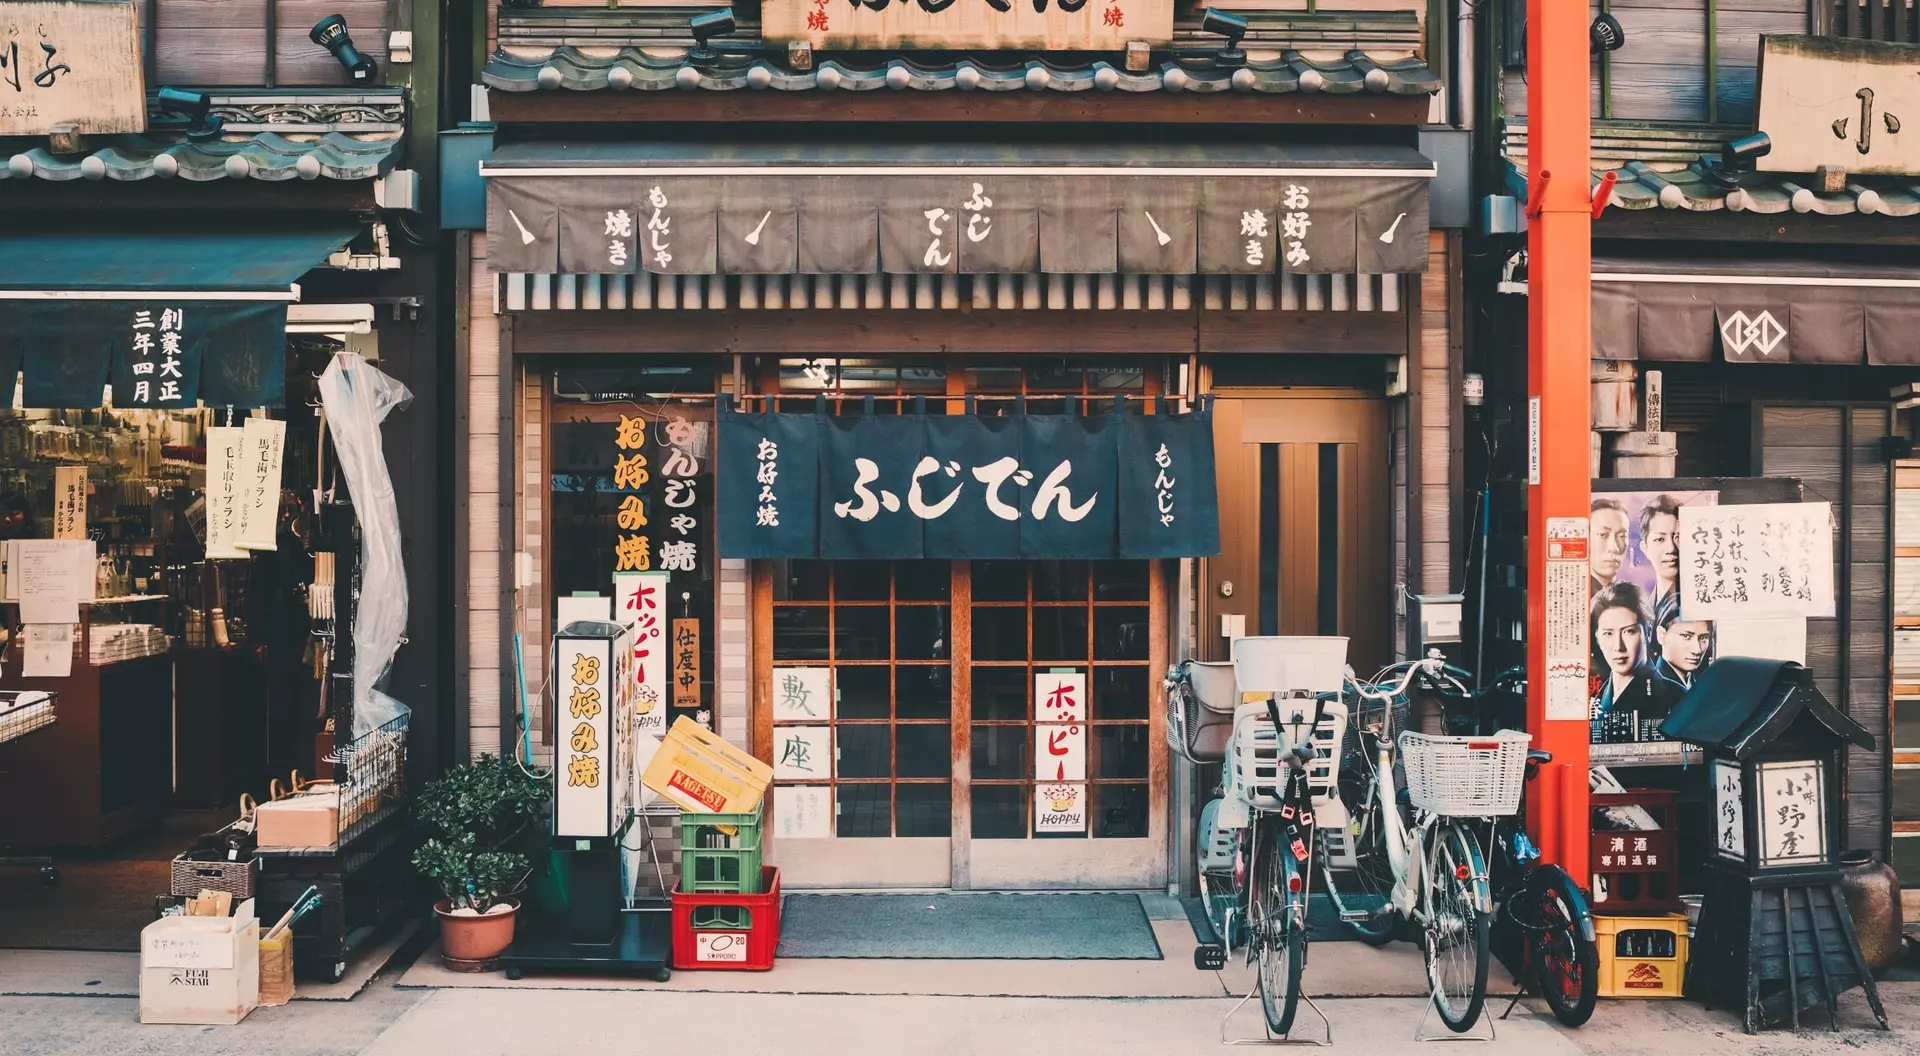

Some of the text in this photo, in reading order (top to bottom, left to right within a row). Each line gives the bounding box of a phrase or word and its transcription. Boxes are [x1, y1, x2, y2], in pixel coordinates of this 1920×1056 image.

[1832, 87, 1900, 155] 小
[604, 209, 632, 266] 焼き
[648, 186, 672, 268] もんじゃ
[924, 208, 951, 266] でん
[964, 183, 993, 242] ふじ
[1240, 209, 1268, 266] 焼き
[1283, 185, 1311, 267] お好み
[133, 310, 155, 403] 三年四月
[159, 308, 183, 400] 創業大正
[222, 446, 235, 529] 毛玉取りブラシ
[255, 438, 270, 509] 馬毛歯ブラシ
[614, 413, 650, 571] お好み焼
[658, 415, 700, 571] もんじゃ焼
[756, 437, 780, 527] お好み焼
[834, 456, 1098, 522] ふじでん
[1154, 443, 1175, 527] もんじゃ
[676, 626, 697, 692] 仕度中
[567, 653, 602, 788] お好み焼
[780, 734, 814, 773] 座
[1046, 680, 1079, 782] ホッピー
[673, 770, 726, 807] KAGETSU
[1776, 777, 1806, 858] 小野屋
[1601, 855, 1657, 866] 専用通箱
[1611, 837, 1648, 852] 清酒
[185, 970, 209, 978] FUJI
[735, 936, 745, 945] 20
[185, 978, 209, 986] STAR
